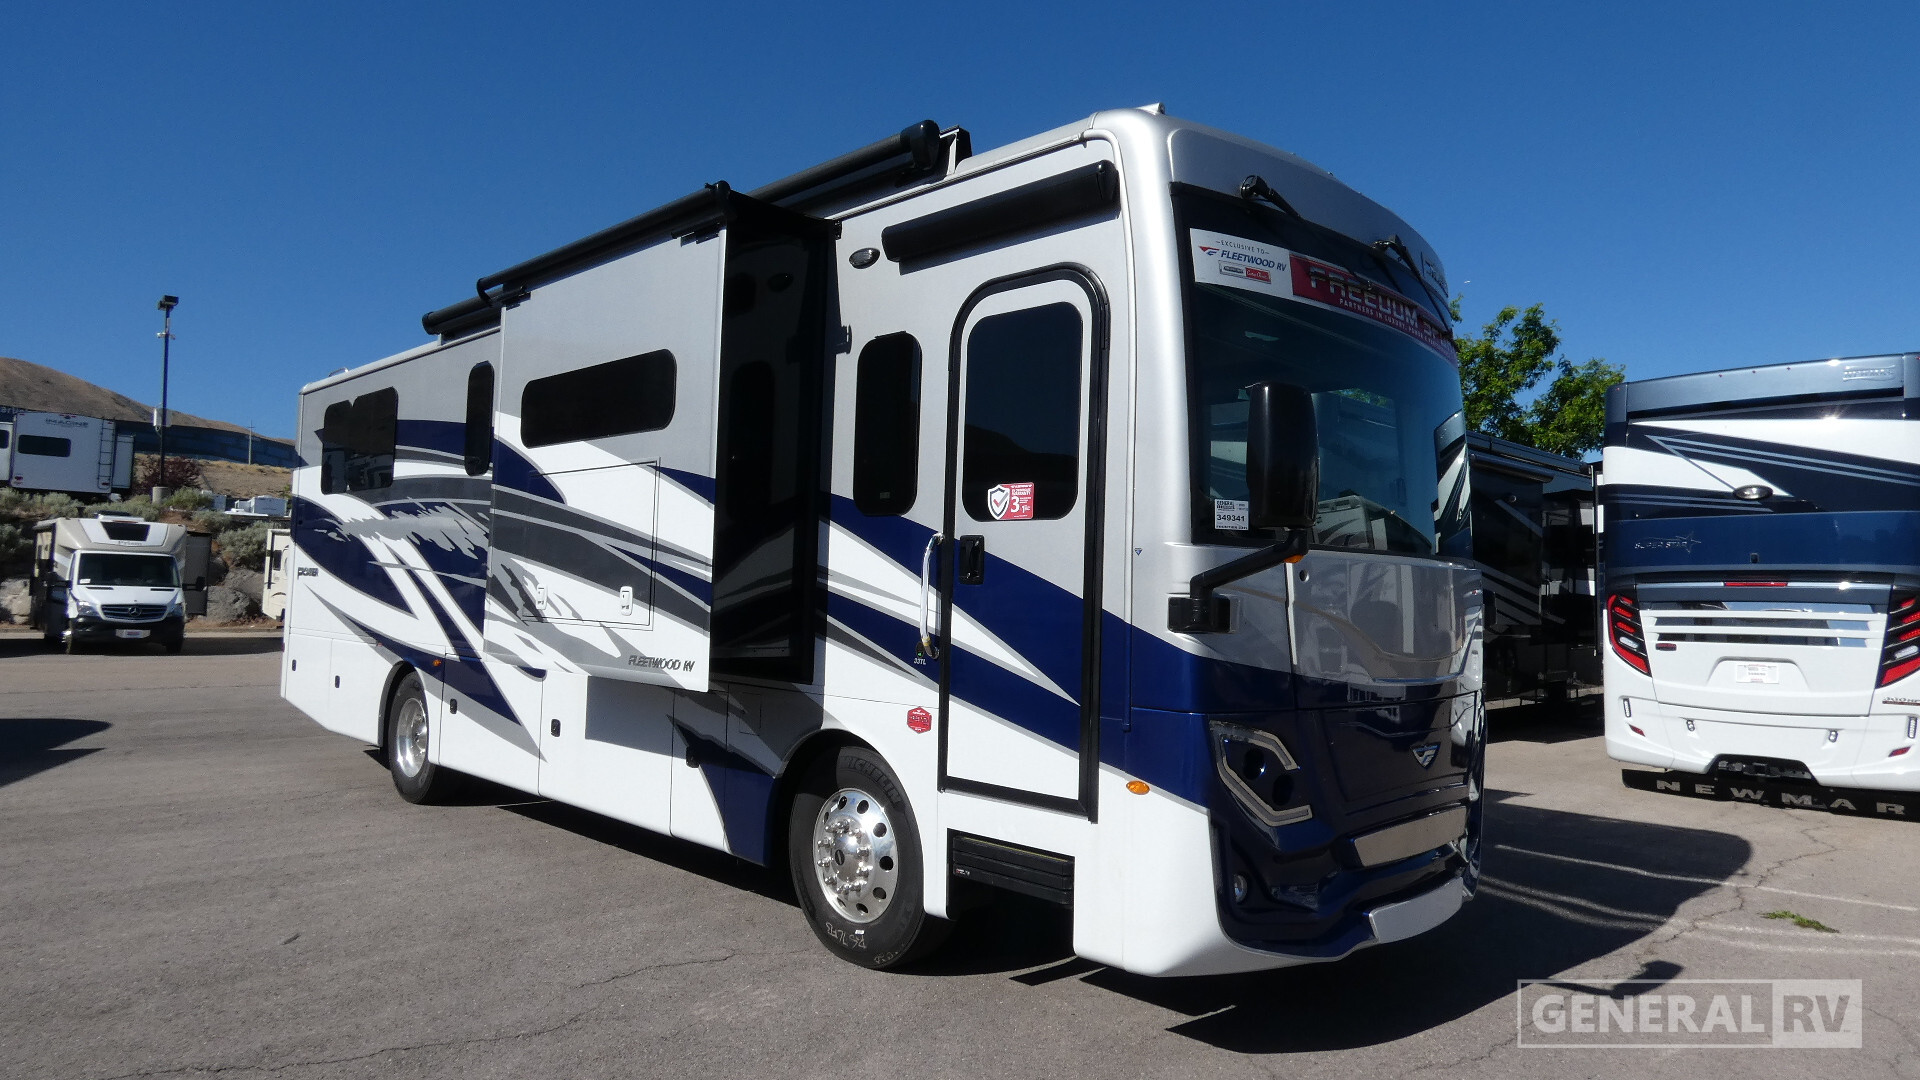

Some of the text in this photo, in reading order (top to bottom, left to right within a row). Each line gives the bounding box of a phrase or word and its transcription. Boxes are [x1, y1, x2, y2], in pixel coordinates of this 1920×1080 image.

[1221, 239, 1255, 252] EXCLUSIVE
[1221, 250, 1287, 272] FLEETWOOD RV
[1339, 298, 1374, 316] PARTNERS
[1376, 310, 1384, 319] IN
[1010, 495, 1020, 512] 3
[1216, 513, 1245, 522] 349341
[628, 654, 681, 670] FLEETWOOD
[913, 657, 927, 665] 33TL
[1656, 779, 1905, 815] NEWMAR
